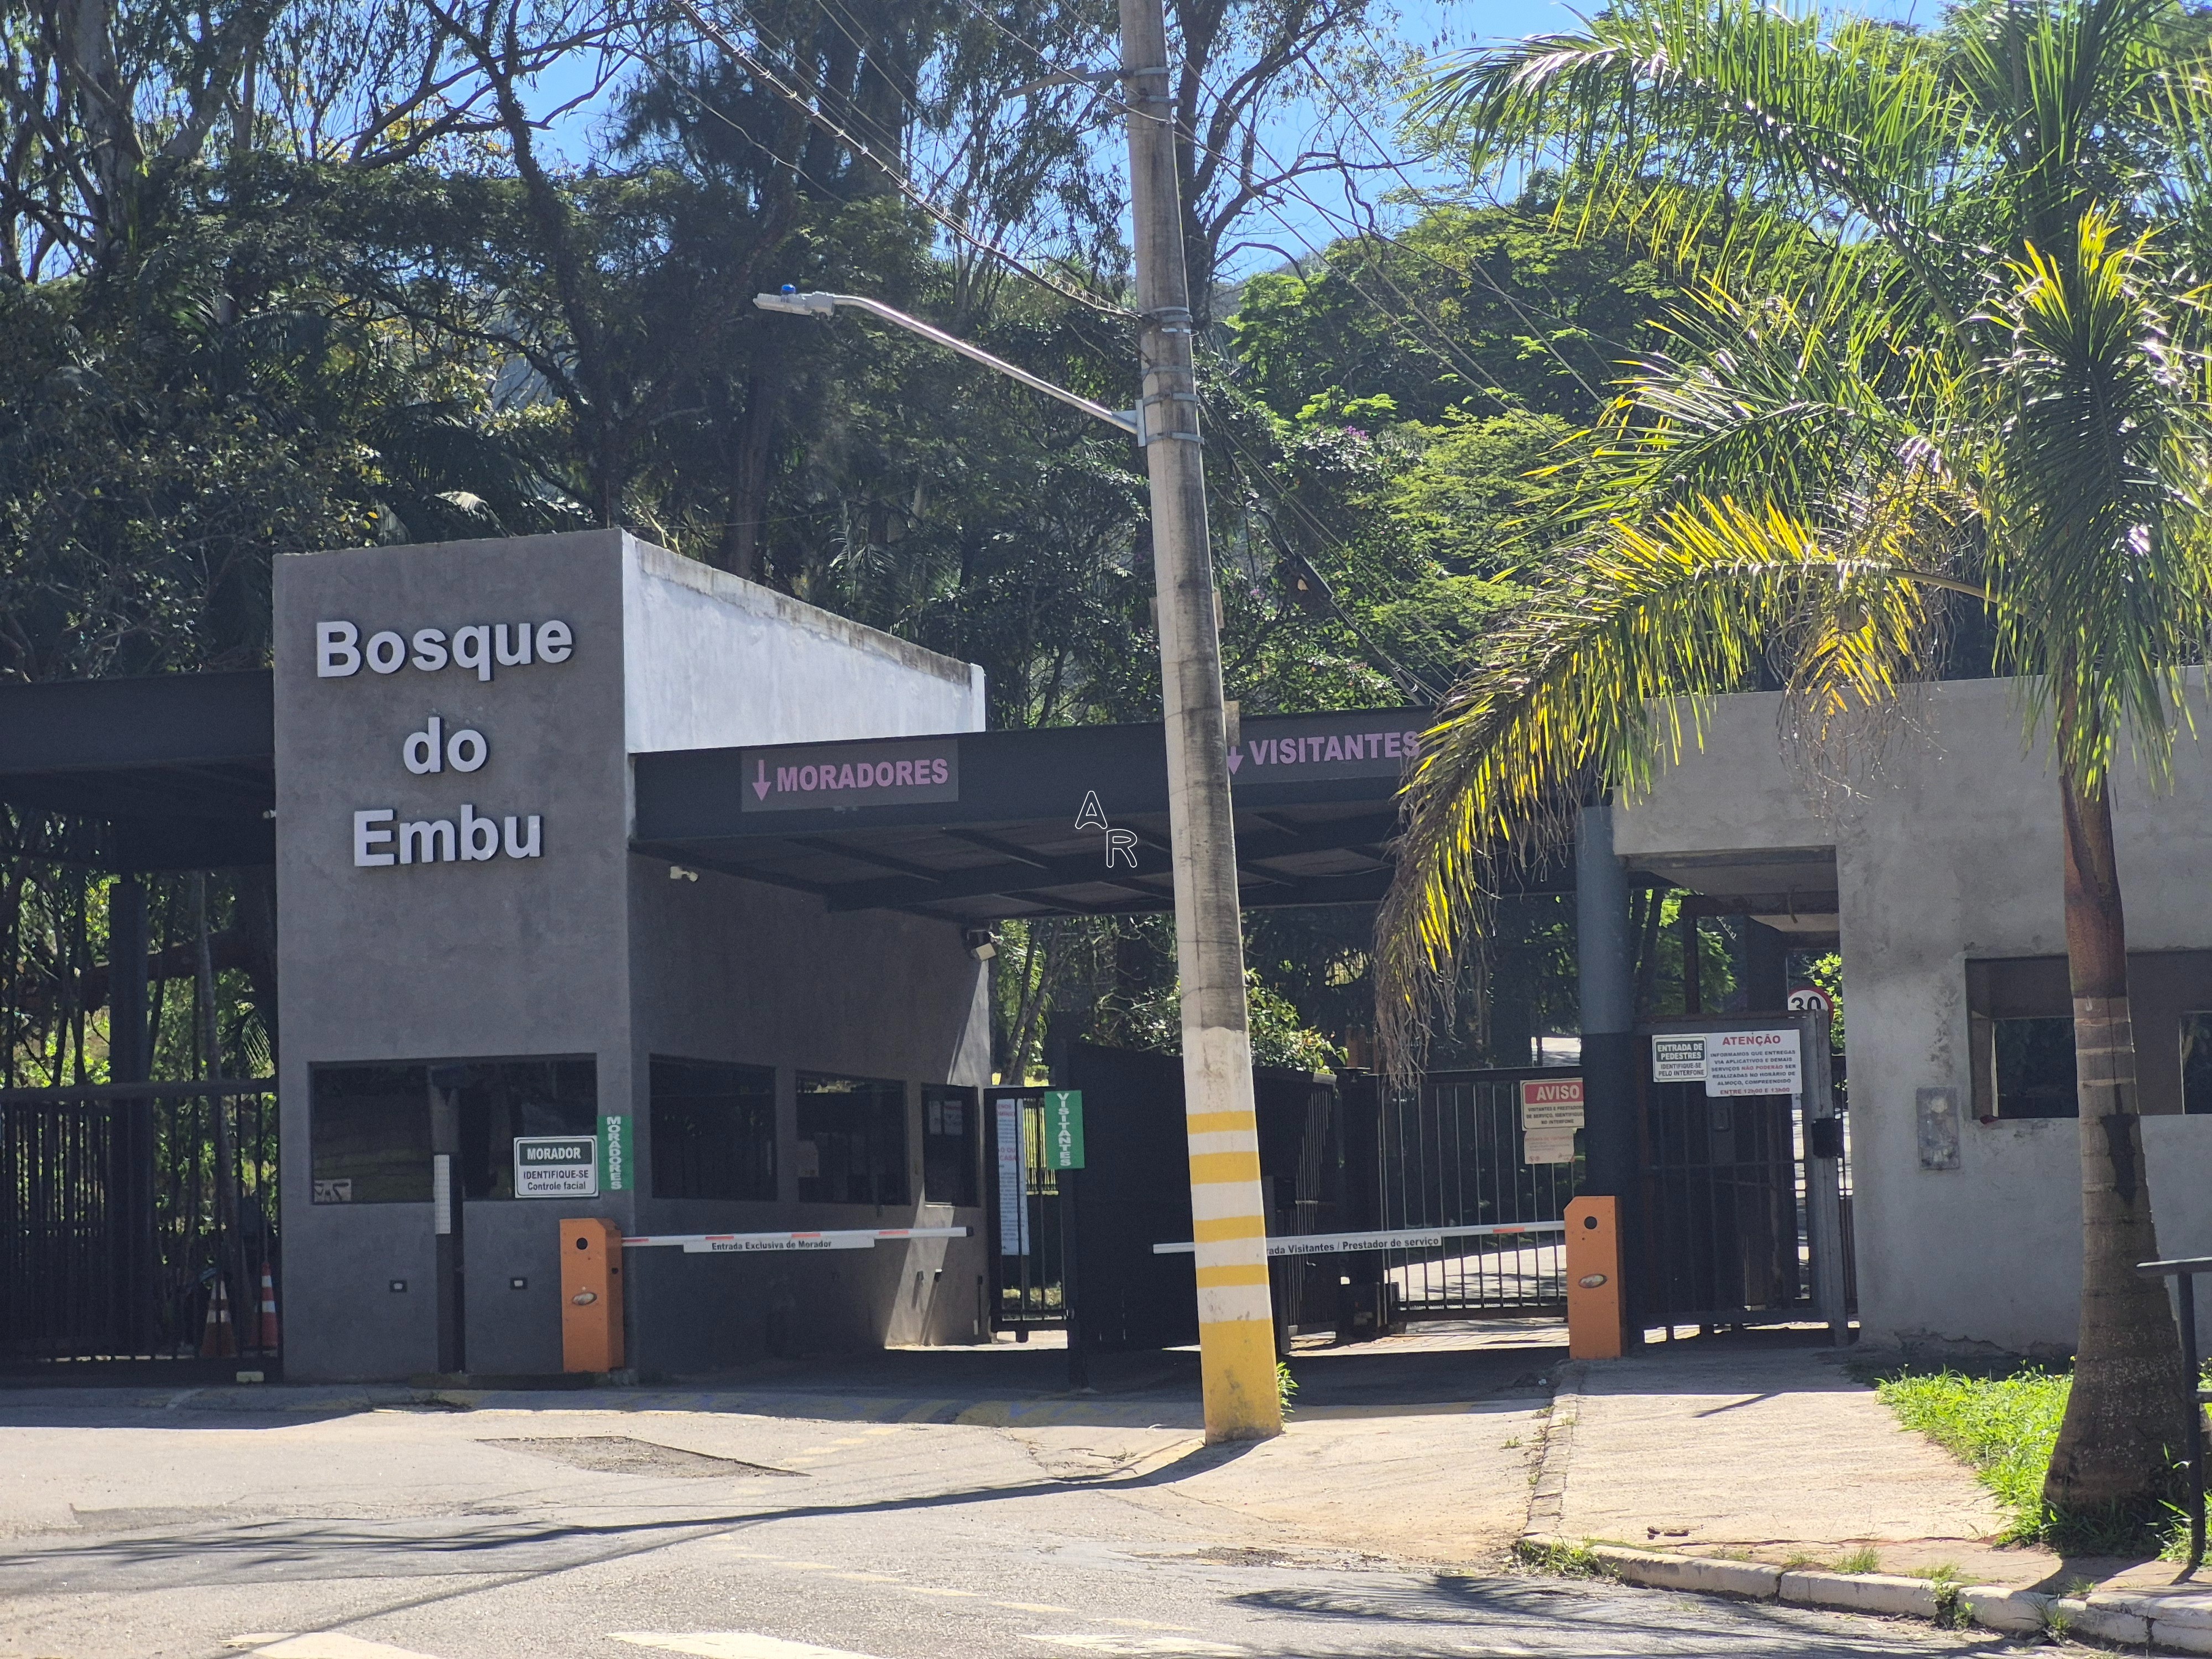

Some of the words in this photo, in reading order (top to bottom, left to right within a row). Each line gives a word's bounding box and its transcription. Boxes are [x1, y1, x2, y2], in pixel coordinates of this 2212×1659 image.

[316, 620, 573, 681] Bosque
[403, 717, 487, 774] do
[1249, 731, 1420, 765] VISITANTES
[777, 758, 948, 791] MORADORES
[354, 805, 541, 867] Embu
[1657, 1044, 1692, 1052] ENTRADA
[1723, 1034, 1781, 1046] ATENÇÃO
[1661, 1052, 1702, 1060] PEDESTRES
[1536, 1084, 1579, 1101] AVISO
[1057, 1093, 1071, 1166] VISITANTES
[527, 1147, 581, 1160] MORADOR
[607, 1117, 622, 1190] MORADORES
[524, 1170, 588, 1180] IDENTIFIQUE-SE
[528, 1181, 561, 1191] Controle
[564, 1181, 586, 1190] facial
[712, 1242, 743, 1250] Entrada
[745, 1241, 784, 1250] Exclusiva
[786, 1240, 796, 1248] de
[799, 1240, 832, 1248] Morador
[1266, 1245, 1285, 1255] rada
[1288, 1244, 1334, 1254] Visitantes
[1343, 1239, 1387, 1250] Prestador
[1390, 1238, 1401, 1248] de
[1405, 1237, 1439, 1246] serviço
